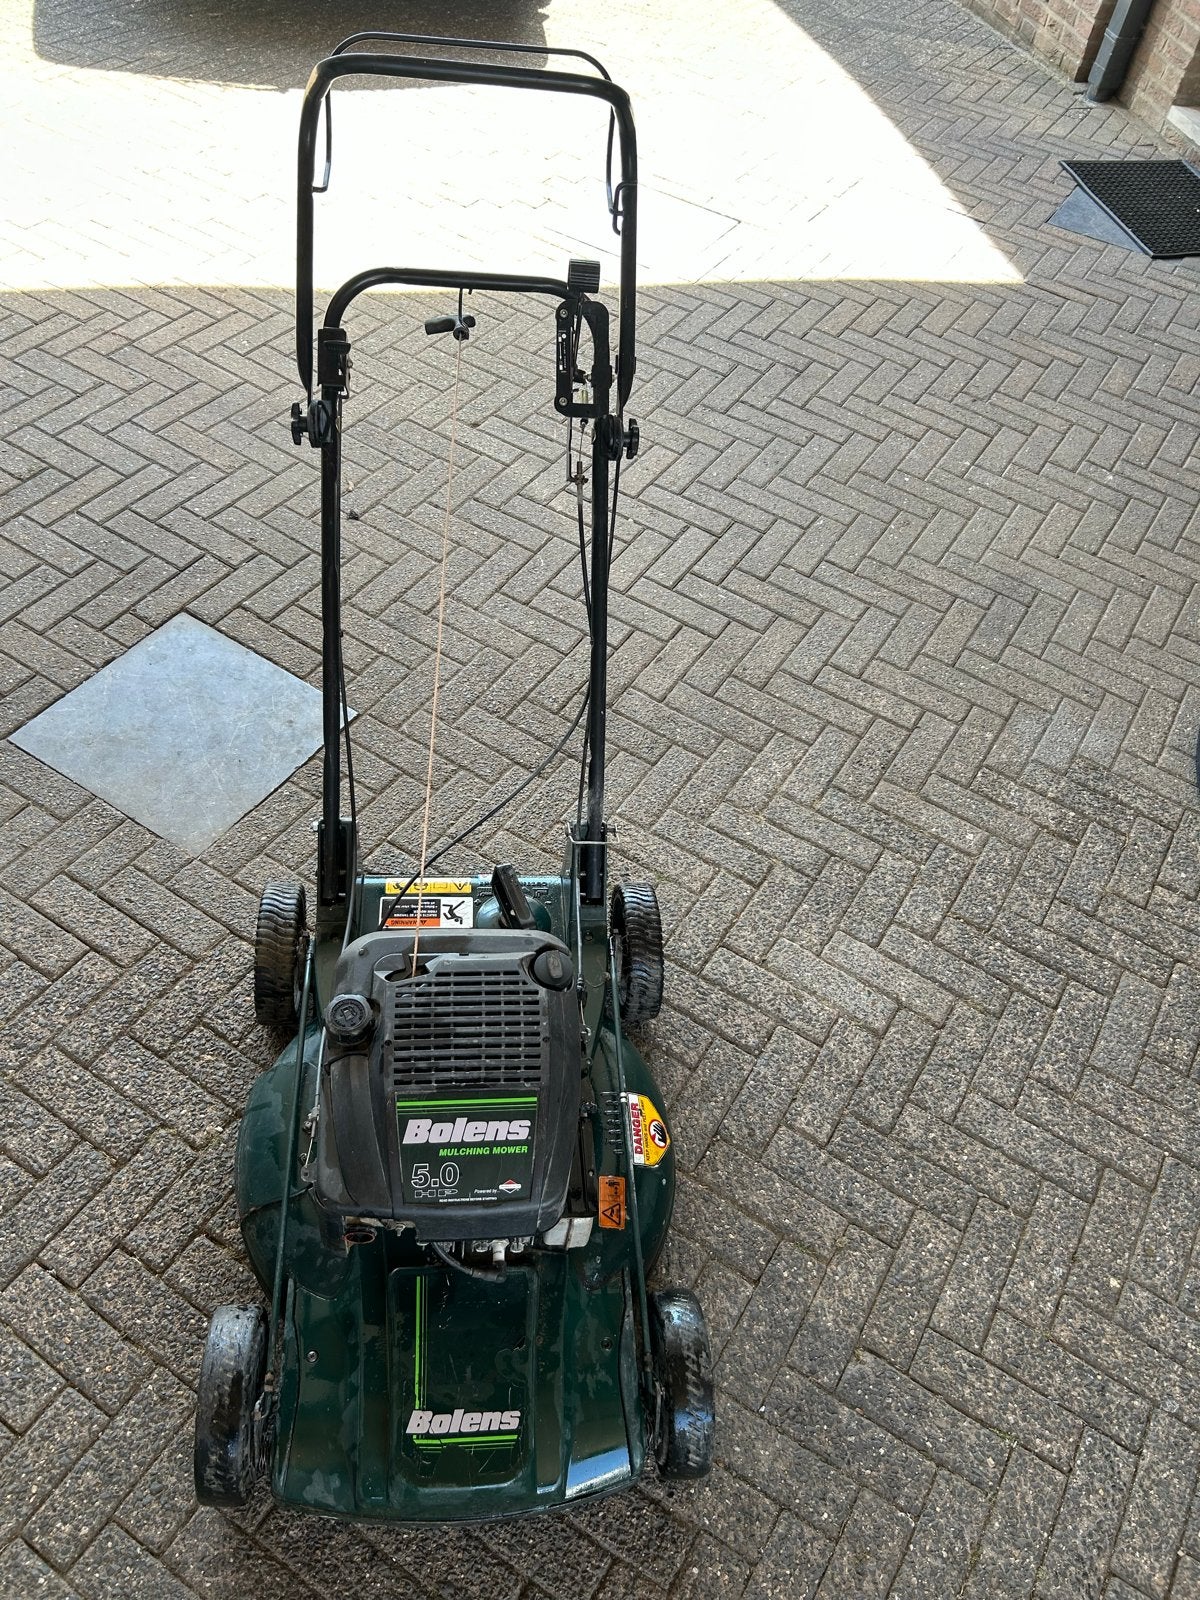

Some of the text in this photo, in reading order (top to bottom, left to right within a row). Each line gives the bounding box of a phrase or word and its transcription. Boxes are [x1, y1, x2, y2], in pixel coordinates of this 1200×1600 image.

[402, 1117, 531, 1144] Bolens
[630, 1102, 643, 1154] DANGER
[439, 1145, 528, 1157] MULCHING MOWER
[411, 1162, 460, 1188] 5.0
[415, 1188, 458, 1198] HP
[405, 1408, 521, 1434] Bolens
